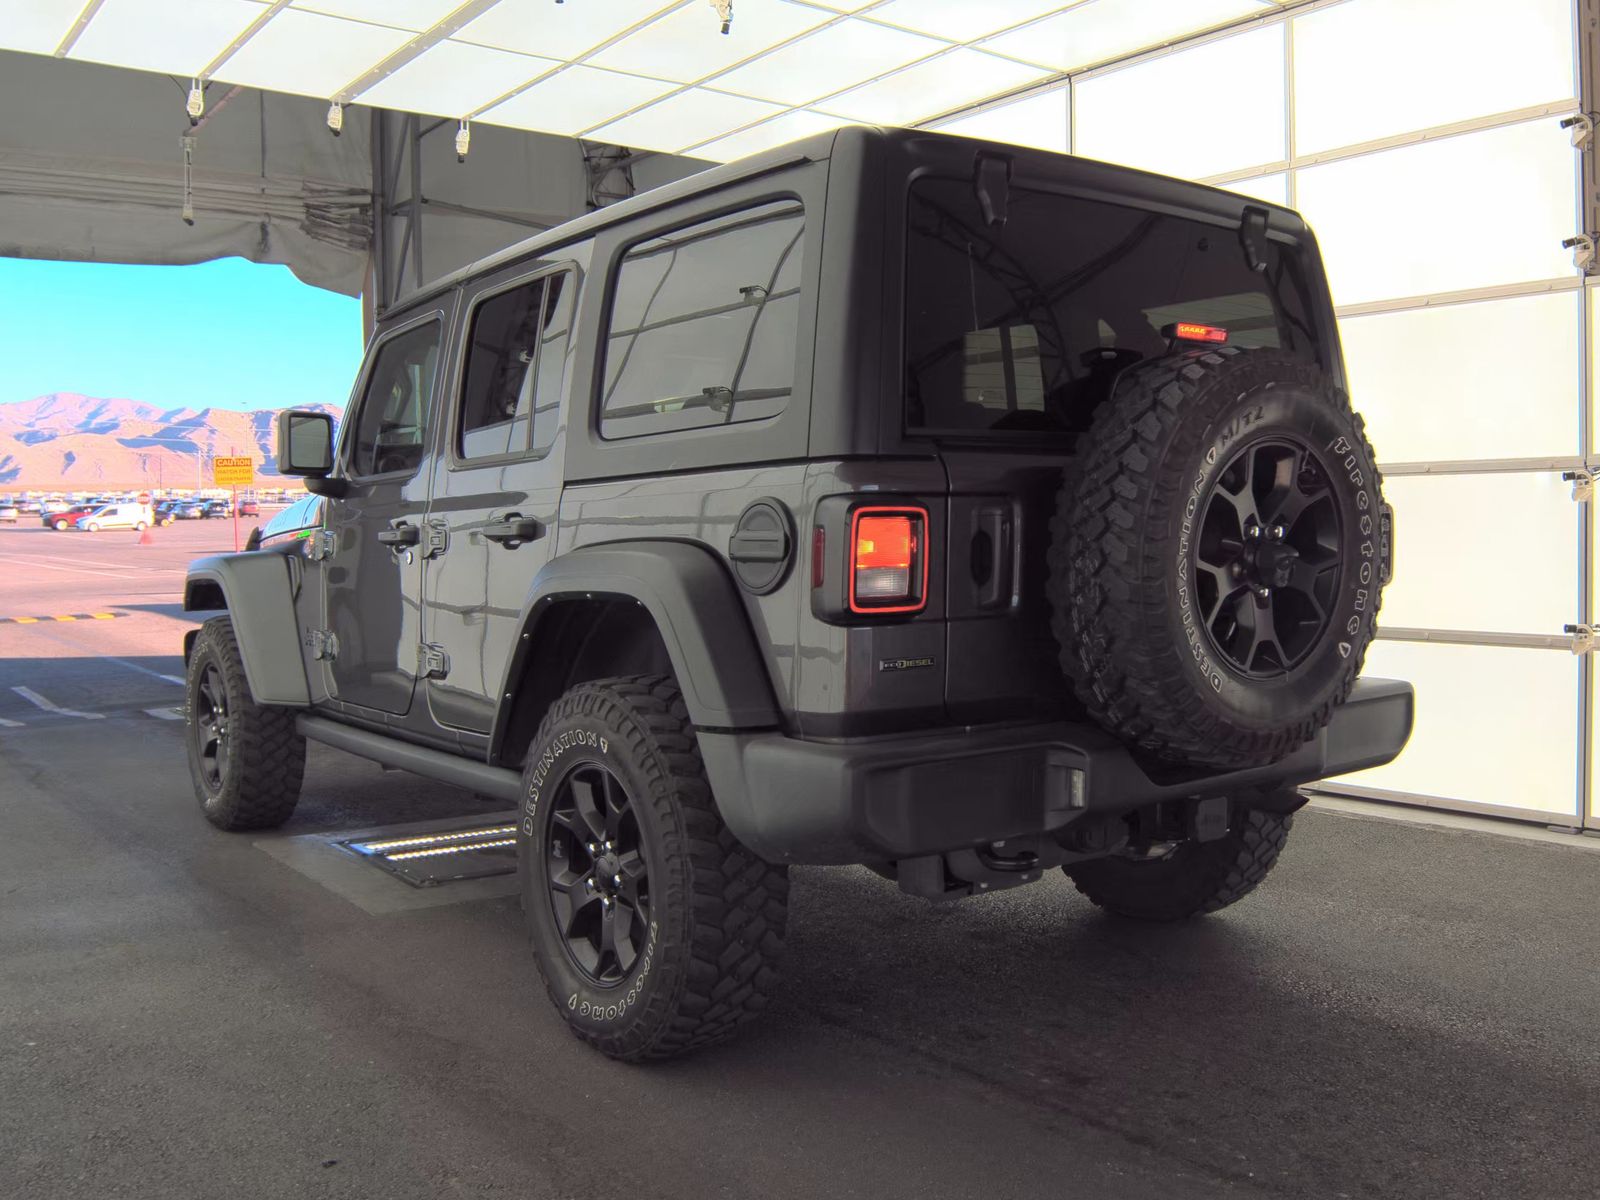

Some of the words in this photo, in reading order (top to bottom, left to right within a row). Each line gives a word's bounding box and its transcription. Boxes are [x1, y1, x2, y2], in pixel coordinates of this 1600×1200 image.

[1179, 471, 1222, 693] DESTINATION
[1334, 436, 1374, 635] Firestone
[523, 728, 598, 836] DESTINATION
